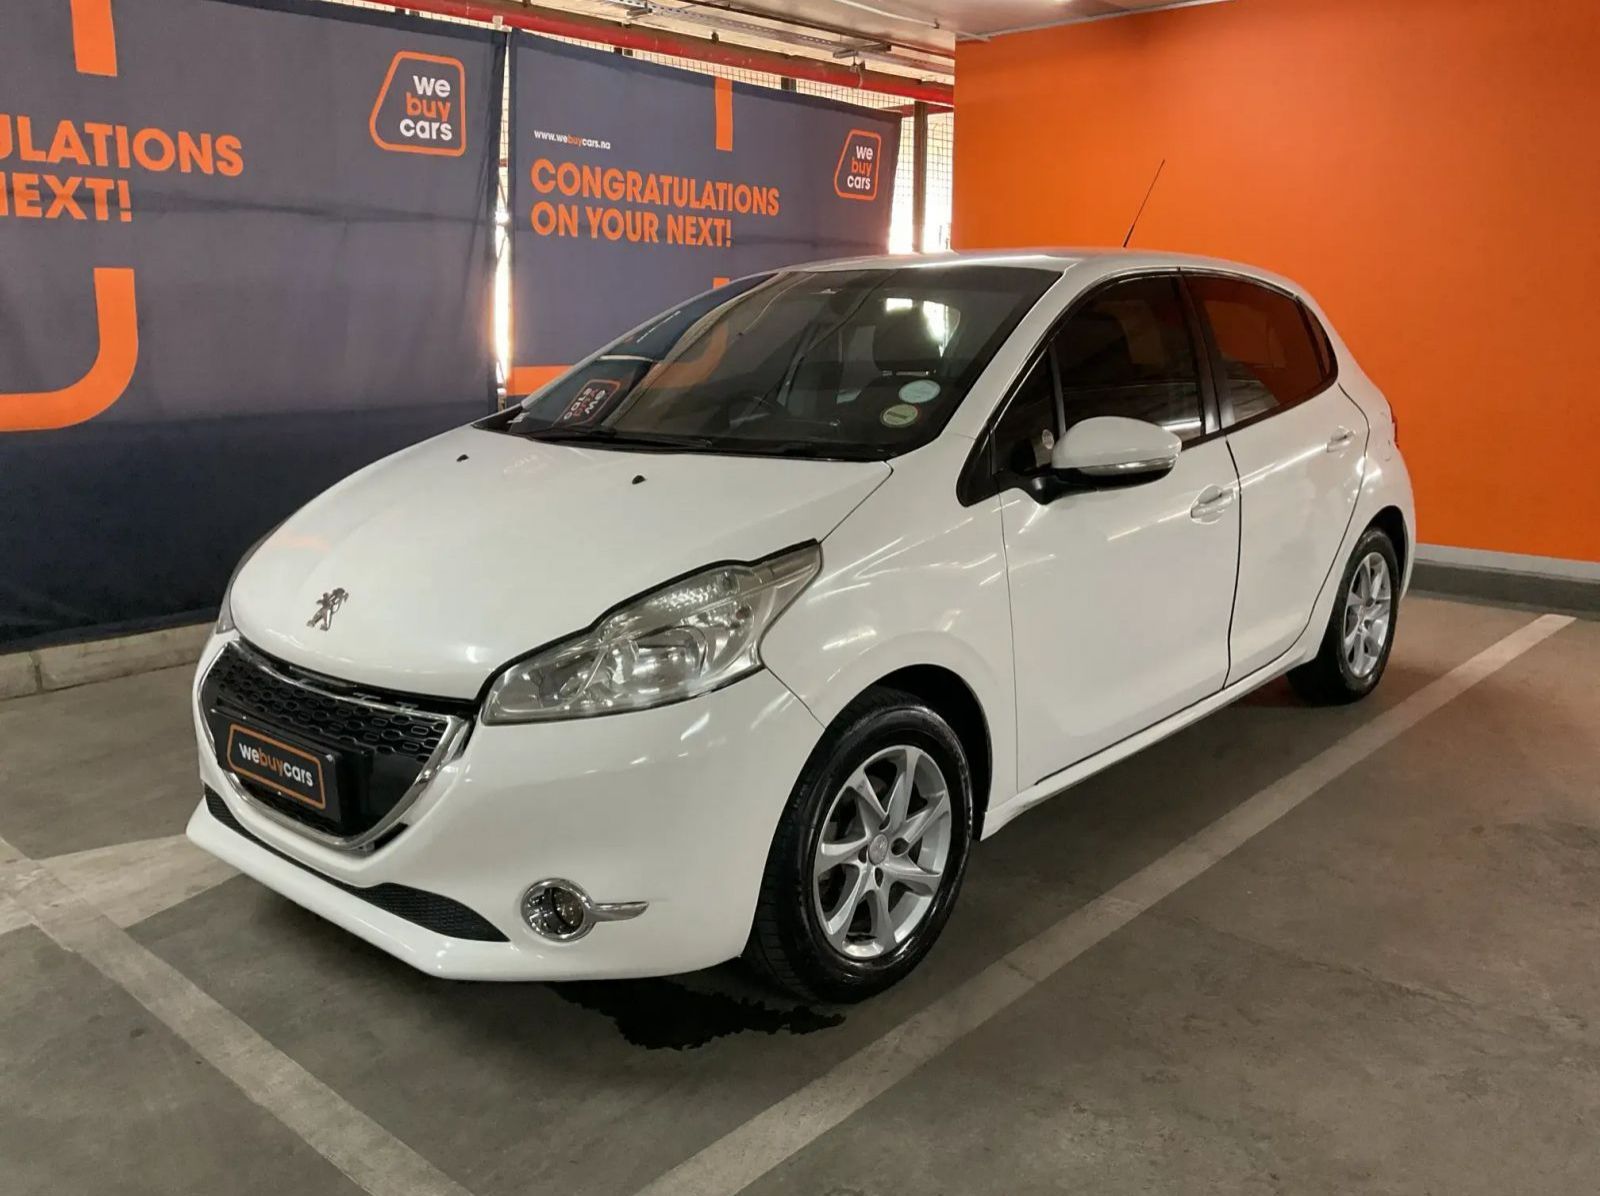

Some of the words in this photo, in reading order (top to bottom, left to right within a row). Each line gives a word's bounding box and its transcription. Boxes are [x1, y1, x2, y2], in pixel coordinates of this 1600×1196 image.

[413, 75, 451, 98] we
[406, 92, 451, 123] buy
[399, 118, 453, 141] cars
[533, 129, 611, 150] www.webuycars.na
[856, 145, 873, 161] we
[851, 156, 872, 175] buy
[530, 157, 780, 217] CONGRATULATIONS
[847, 174, 871, 190] cars
[0, 171, 132, 222] EXT!
[531, 200, 579, 239] ON
[586, 207, 659, 244] YOUR
[666, 215, 732, 248] NEXT!
[239, 742, 314, 787] webuycars
